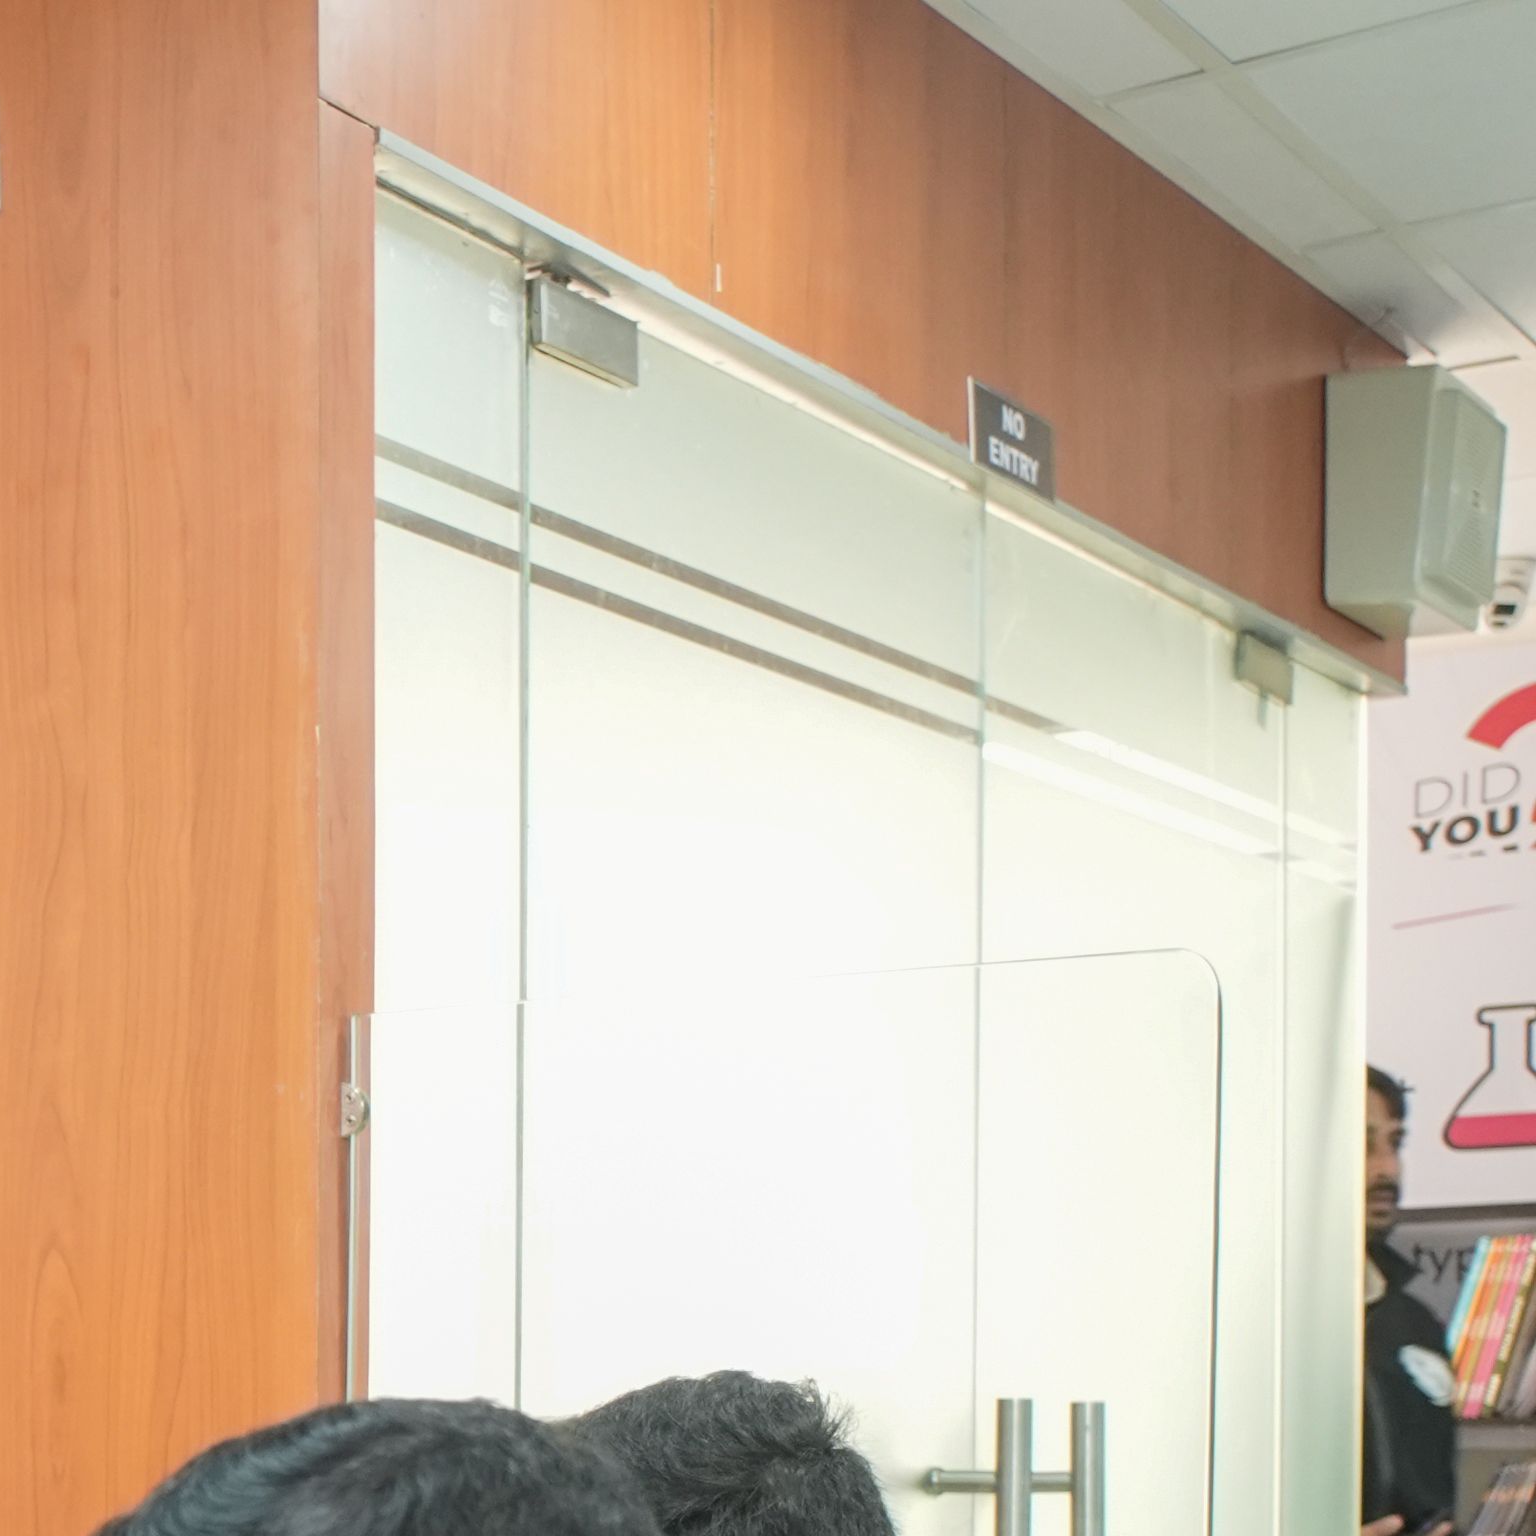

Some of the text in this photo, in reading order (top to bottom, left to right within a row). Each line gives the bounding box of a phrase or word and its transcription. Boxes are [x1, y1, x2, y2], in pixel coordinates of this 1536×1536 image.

[1001, 404, 1026, 441] NO
[989, 435, 1039, 485] ENTRY
[1414, 761, 1521, 819] DID
[1409, 804, 1520, 854] YOU
